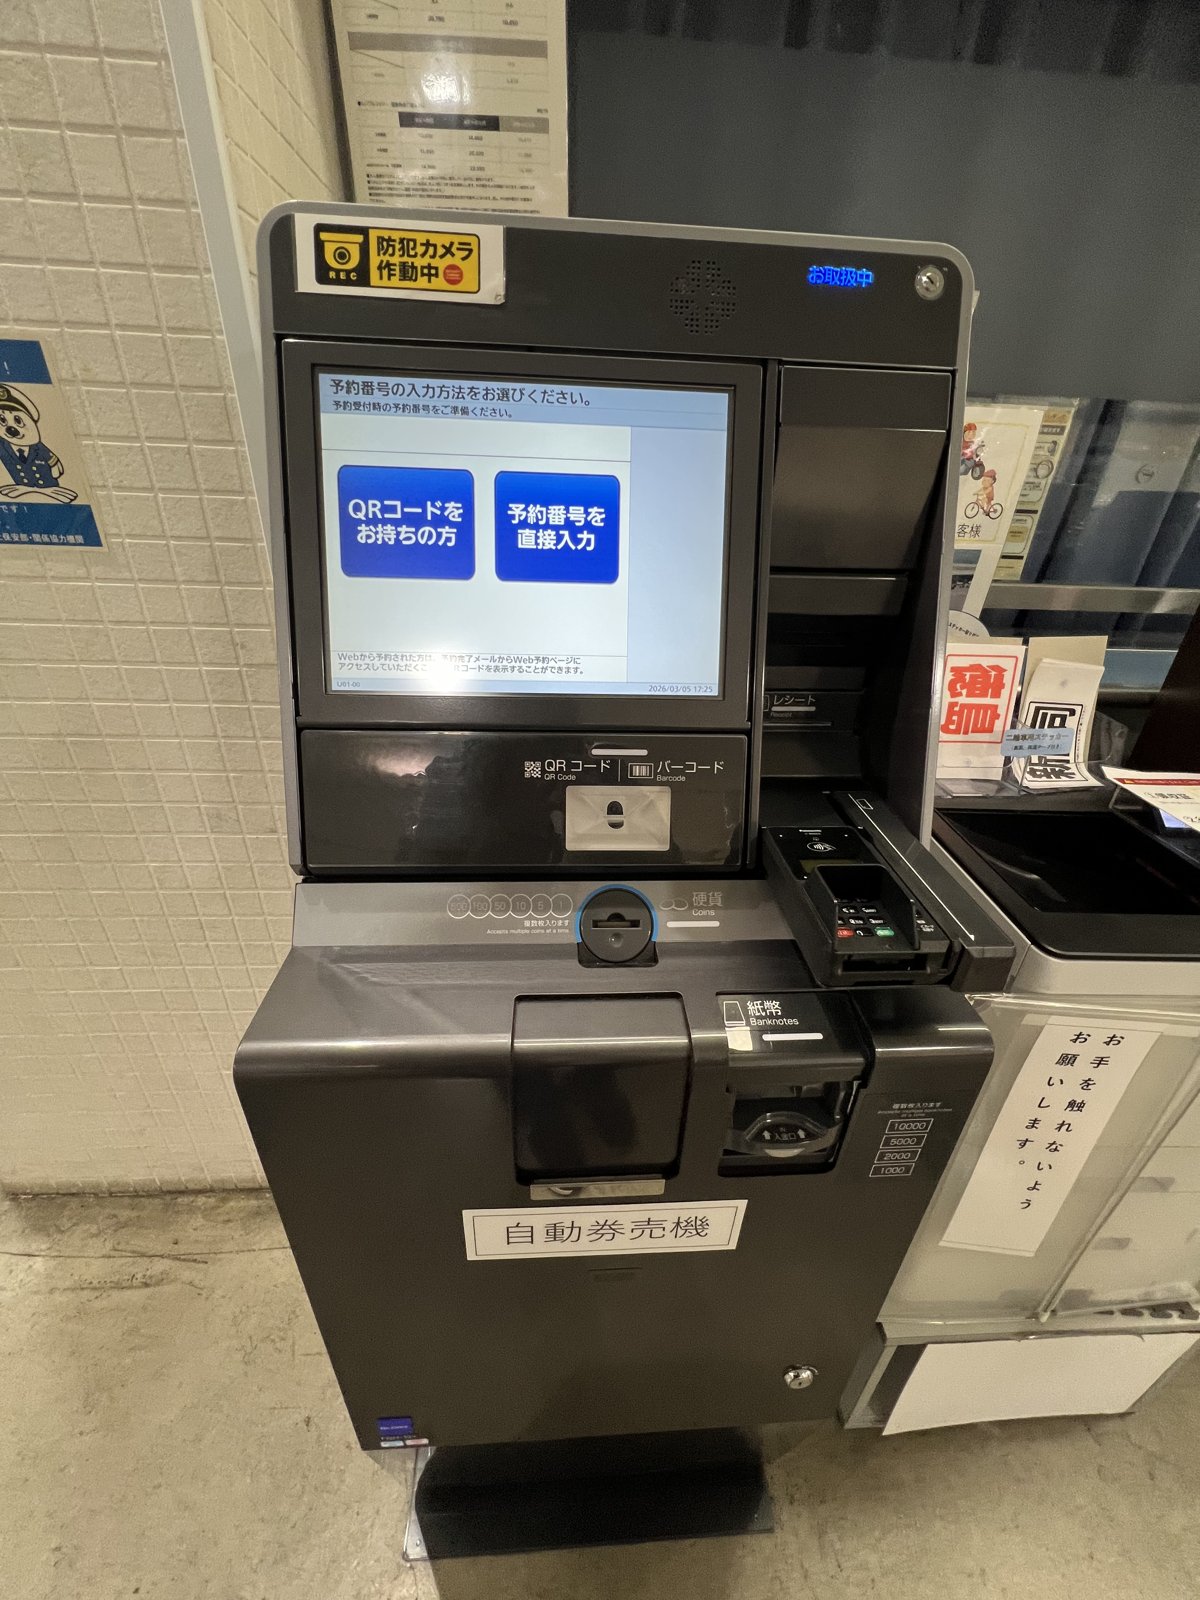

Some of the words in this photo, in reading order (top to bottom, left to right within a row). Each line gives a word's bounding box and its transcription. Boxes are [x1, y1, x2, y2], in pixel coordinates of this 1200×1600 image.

[376, 235, 474, 262] 防犯カメラ
[328, 271, 358, 281] REC
[376, 259, 440, 284] 作動中
[807, 265, 874, 288] お取扱中
[330, 378, 591, 407] 予約番号の入力方法をお選びください。
[332, 400, 513, 419] 予約受付時の予約番号をご準備ください。
[347, 498, 464, 523] QRコードを
[506, 503, 606, 527] 予約番号を
[356, 523, 458, 547] お持ちの方
[516, 529, 596, 552] 直接入力
[648, 684, 692, 693] 2026/03/05
[693, 685, 713, 694] 17:25
[773, 694, 816, 706] レシート
[1026, 705, 1077, 780] 新司
[544, 759, 567, 773] QR
[569, 759, 611, 773] コード
[656, 760, 725, 775] バーコード
[544, 773, 556, 781] QR
[557, 773, 577, 781] Code
[656, 774, 686, 782] Barcode
[494, 901, 506, 910] 50
[516, 901, 527, 910] 10
[692, 891, 724, 908] 硬貨
[692, 908, 716, 916] Coins
[746, 1000, 782, 1017] 紙幣
[750, 1017, 800, 1026] Banknotes
[1016, 1030, 1092, 1167] お願いします。
[893, 1122, 927, 1131] 10000
[1019, 1032, 1126, 1211] お手を触れないよう
[889, 1137, 917, 1146] 5000
[883, 1152, 911, 1161] 2000
[880, 1166, 906, 1175] 1000
[505, 1215, 711, 1246] 自動券売機
